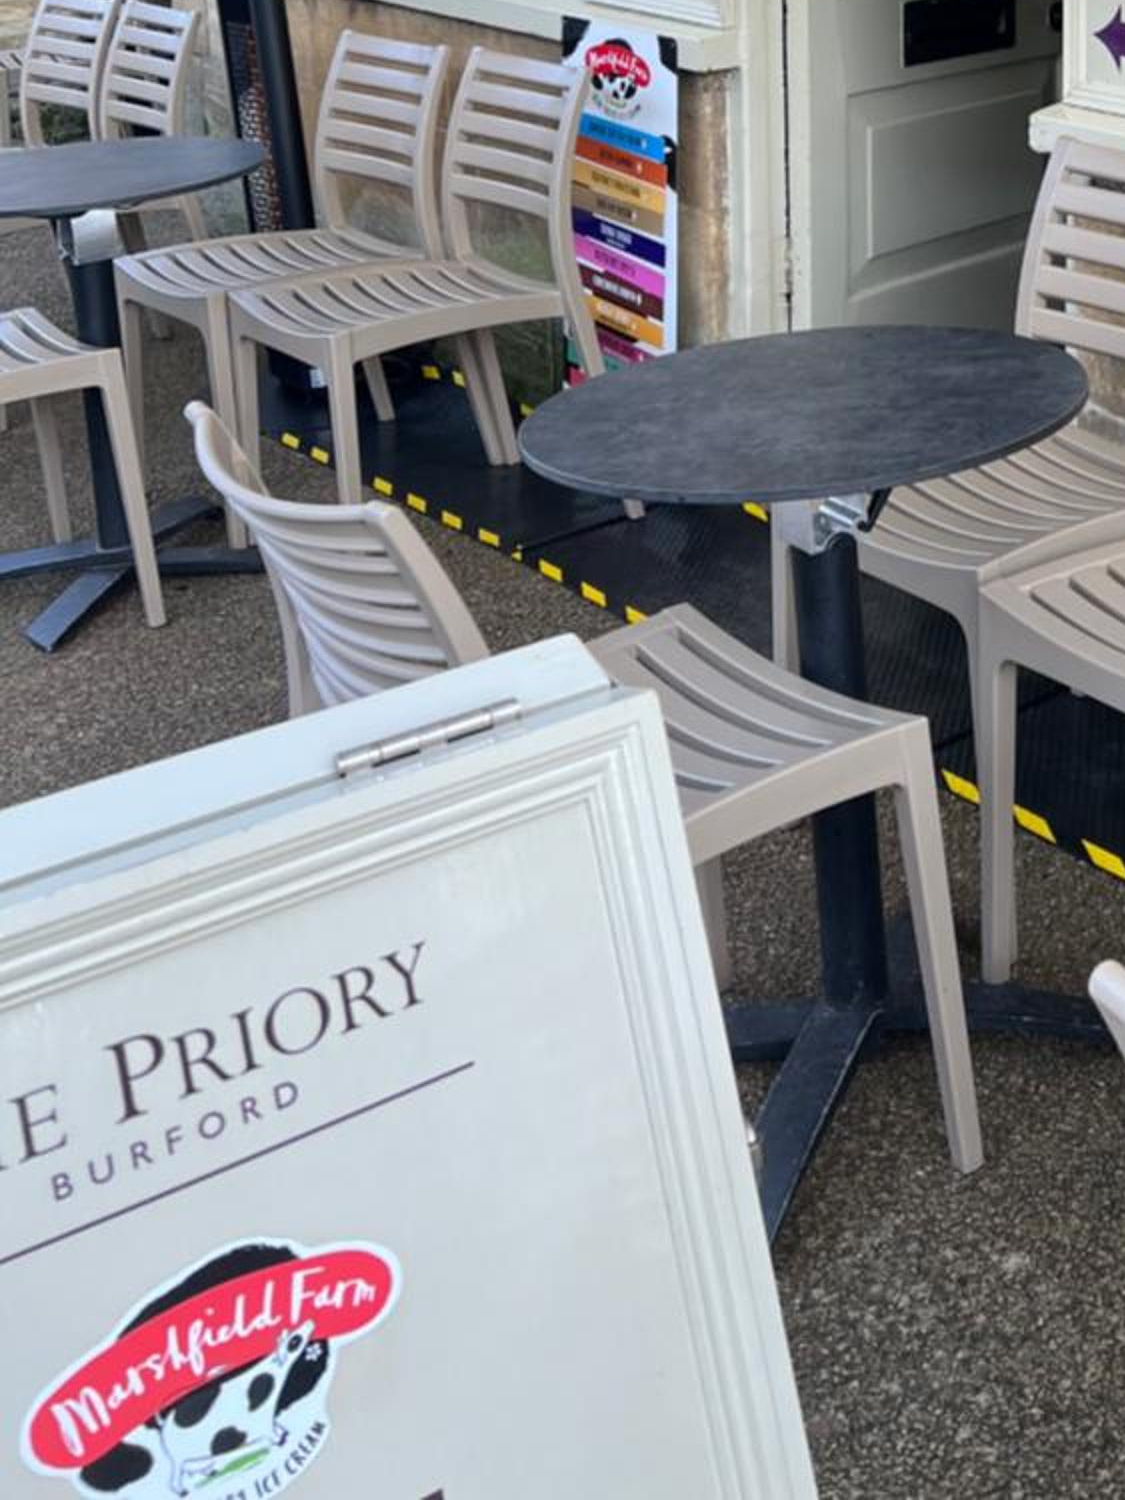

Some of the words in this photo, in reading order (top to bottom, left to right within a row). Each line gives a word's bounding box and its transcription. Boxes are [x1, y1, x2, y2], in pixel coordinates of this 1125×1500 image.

[103, 941, 426, 1126] PRIORY
[51, 1081, 300, 1202] BURFORD
[49, 1280, 282, 1458] Marshfield
[290, 1265, 378, 1325] Farm
[283, 1419, 327, 1476] CREAM
